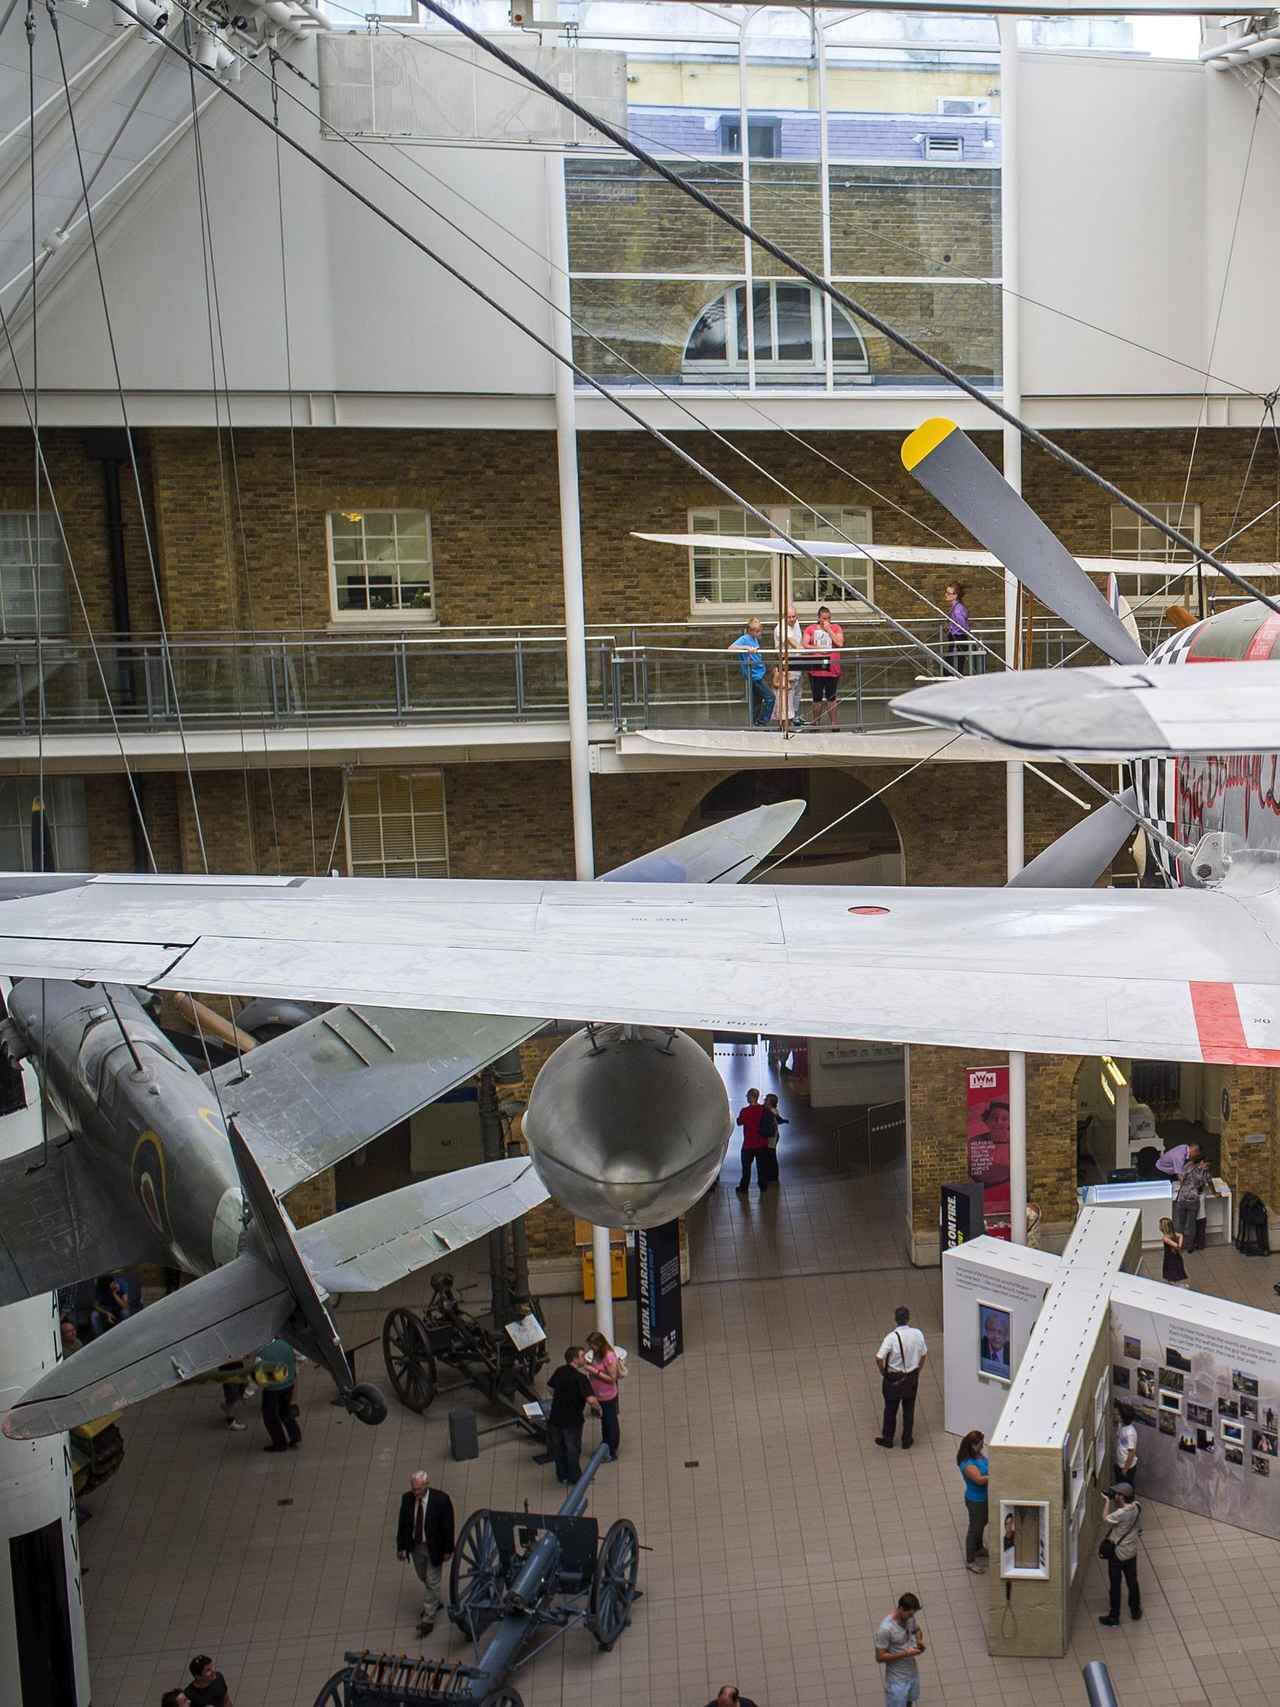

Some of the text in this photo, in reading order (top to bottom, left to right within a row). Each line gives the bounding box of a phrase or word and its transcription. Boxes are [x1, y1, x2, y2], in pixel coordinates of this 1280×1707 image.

[973, 1072, 995, 1086] IWM
[948, 1195, 957, 1221] FIRE.
[948, 1222, 957, 1240] ON
[642, 1338, 651, 1350] 2
